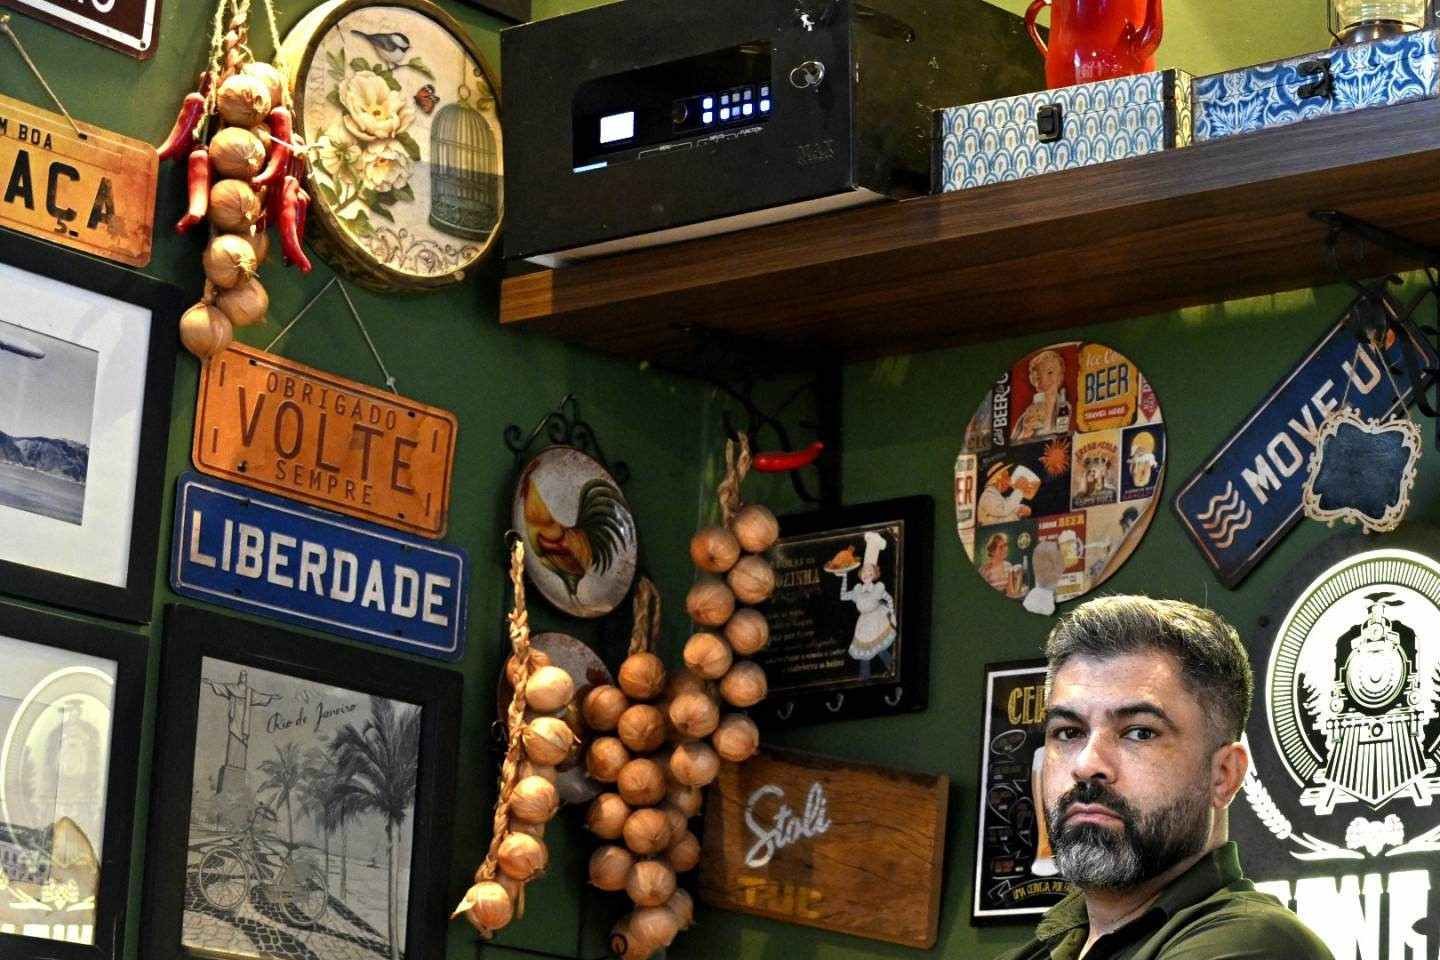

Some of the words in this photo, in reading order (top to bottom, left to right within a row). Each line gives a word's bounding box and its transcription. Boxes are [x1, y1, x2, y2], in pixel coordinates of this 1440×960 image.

[18, 124, 53, 151] BOA
[266, 371, 398, 432] OBRIGADO
[992, 385, 1011, 428] BEER
[1085, 364, 1128, 405] BEER
[238, 385, 419, 496] VOLTE
[1241, 379, 1338, 505] MOVE
[1339, 343, 1382, 395] U
[275, 459, 374, 506] SEMPRE
[189, 509, 452, 628] LIBERDADE
[744, 782, 833, 869] Stoli
